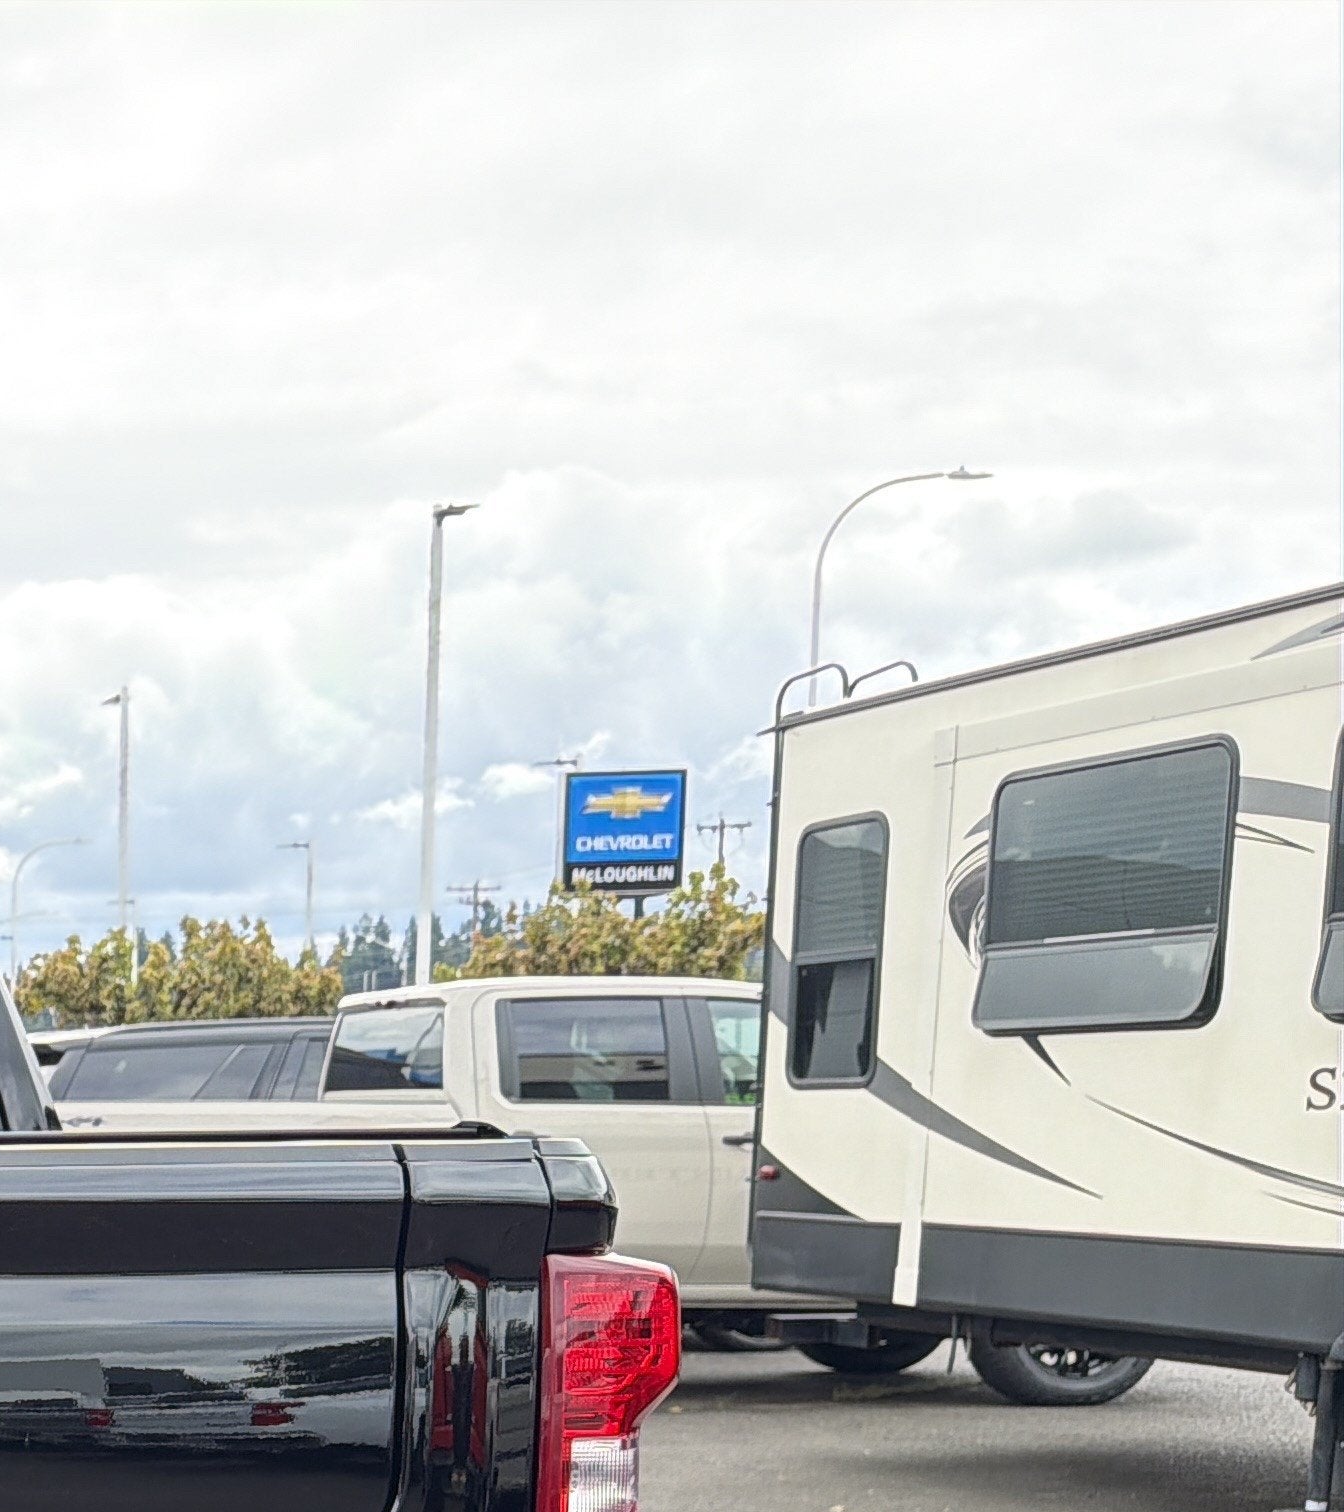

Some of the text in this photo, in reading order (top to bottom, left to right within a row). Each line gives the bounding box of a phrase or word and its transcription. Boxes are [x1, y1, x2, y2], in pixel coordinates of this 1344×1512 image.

[575, 832, 674, 852] CHEVROLET
[571, 865, 675, 884] McLOUGHLIN
[1305, 1066, 1344, 1112] S
